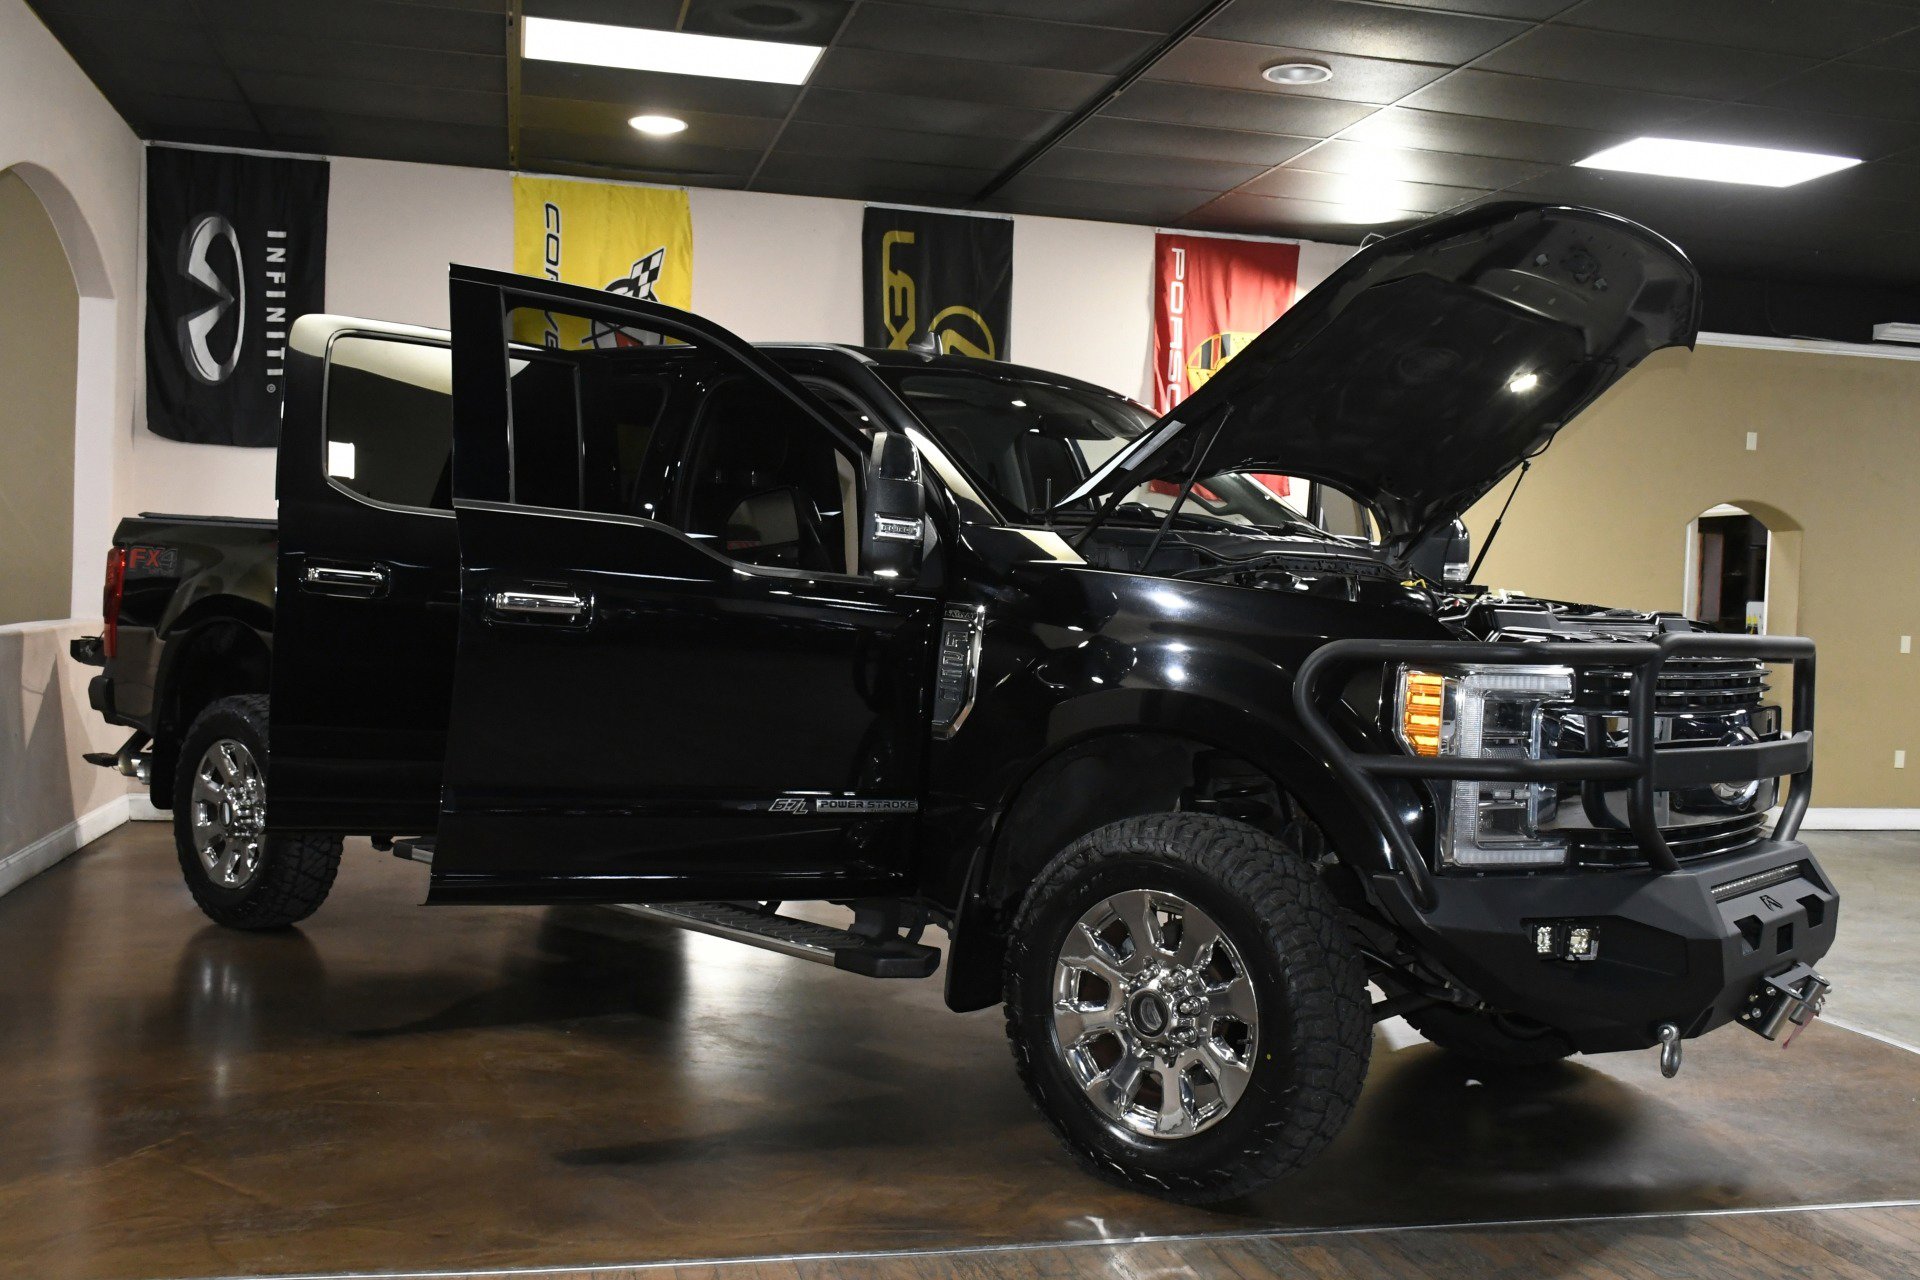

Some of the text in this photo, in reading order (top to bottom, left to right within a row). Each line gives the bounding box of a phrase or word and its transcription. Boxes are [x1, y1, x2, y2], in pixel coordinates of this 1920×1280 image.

[266, 231, 287, 376] INFINITI
[129, 547, 177, 569] FX4
[820, 800, 917, 809] POWER STROKE
